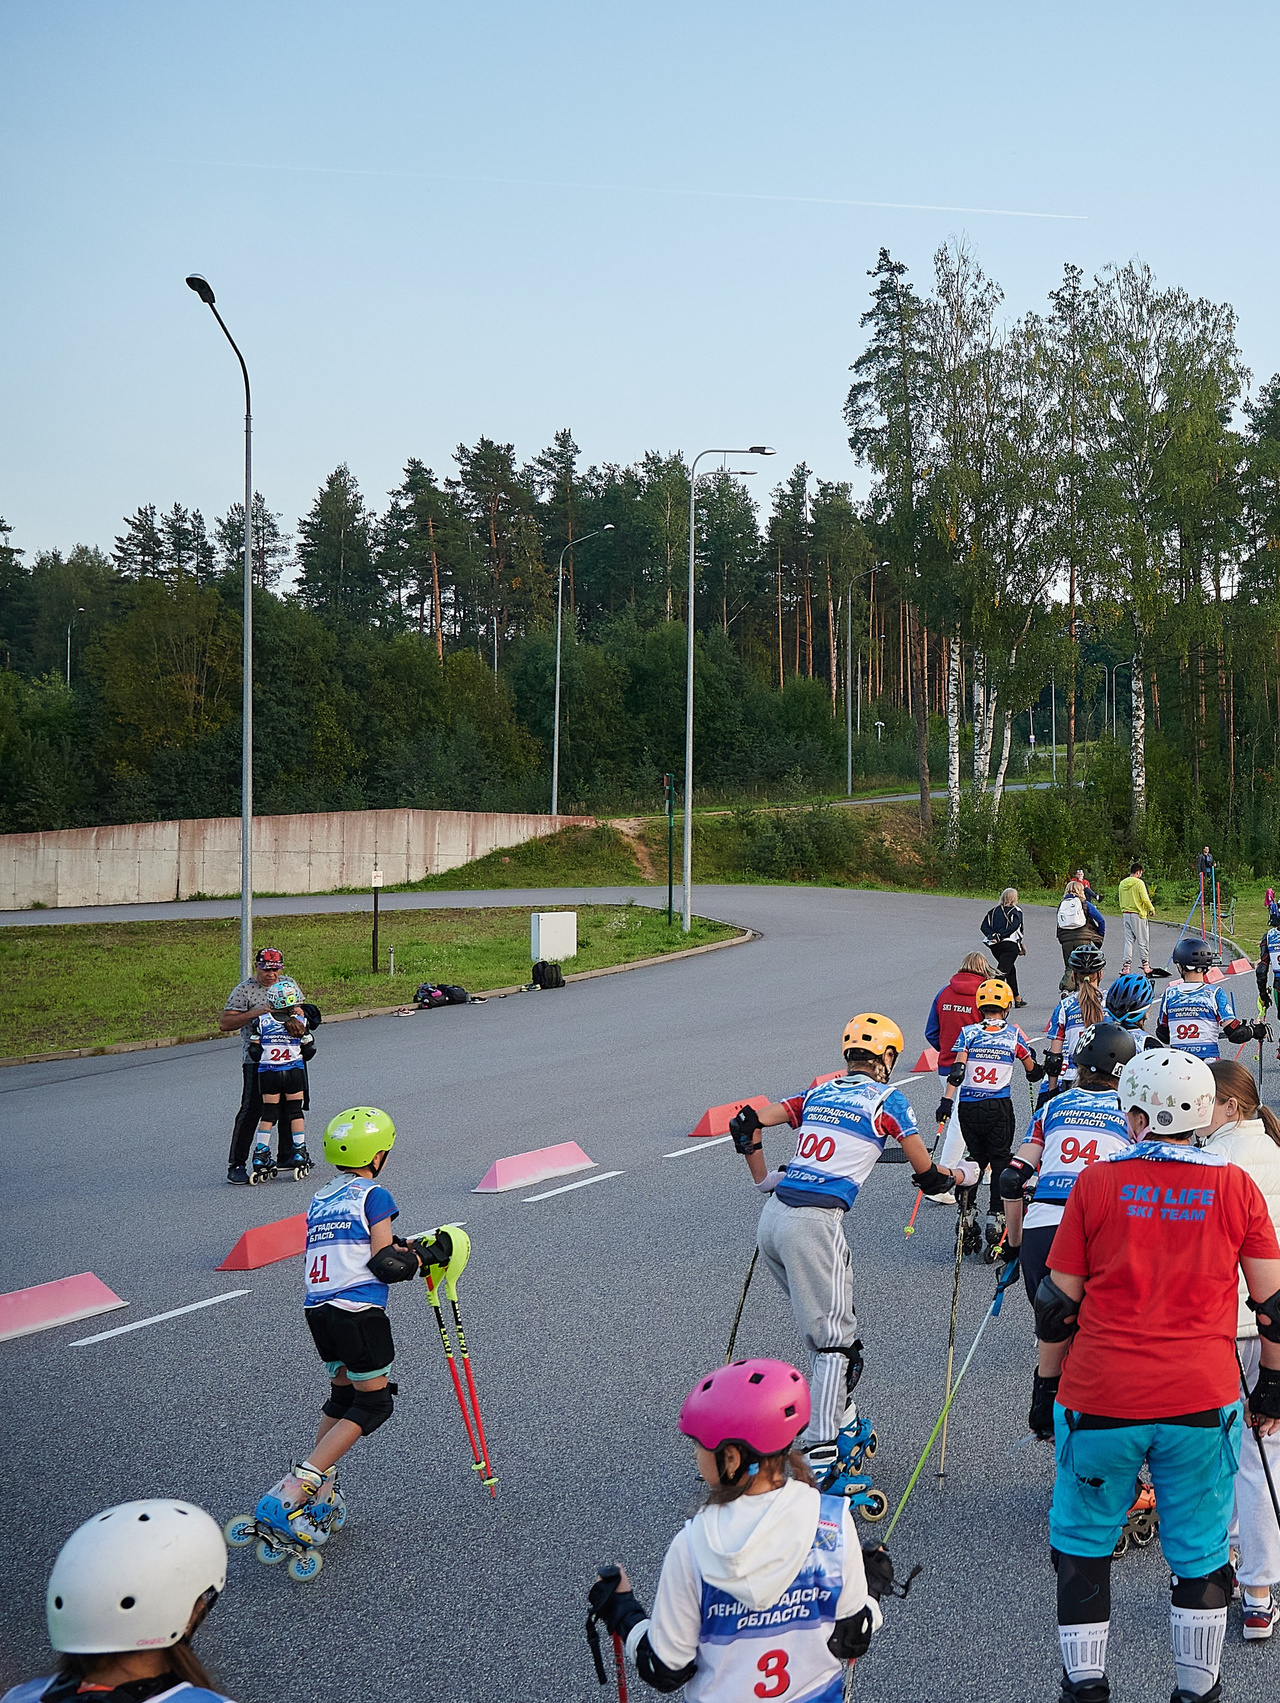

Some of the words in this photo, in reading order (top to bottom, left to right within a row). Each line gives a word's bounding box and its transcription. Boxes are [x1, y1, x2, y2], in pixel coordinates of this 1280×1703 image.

[942, 1003, 952, 1011] SKI
[953, 1005, 972, 1014] TEAM
[1176, 1023, 1200, 1040] 92
[270, 1048, 291, 1061] 24
[972, 1066, 998, 1085] 34
[806, 1113, 840, 1125] ОБЛАСТЬ
[1064, 1117, 1106, 1128] ОБЛАСТЬ
[1060, 1136, 1101, 1166] 94
[1120, 1184, 1160, 1202] SKI
[1164, 1188, 1215, 1206] LIFE
[1127, 1205, 1153, 1218] SKI
[1160, 1208, 1206, 1221] TEAM
[309, 1254, 330, 1284] 41
[440, 1328, 452, 1353] LEKI
[456, 1325, 467, 1351] LEKI
[737, 1604, 810, 1630] ОБЛАСТЬ
[754, 1649, 790, 1699] 3
